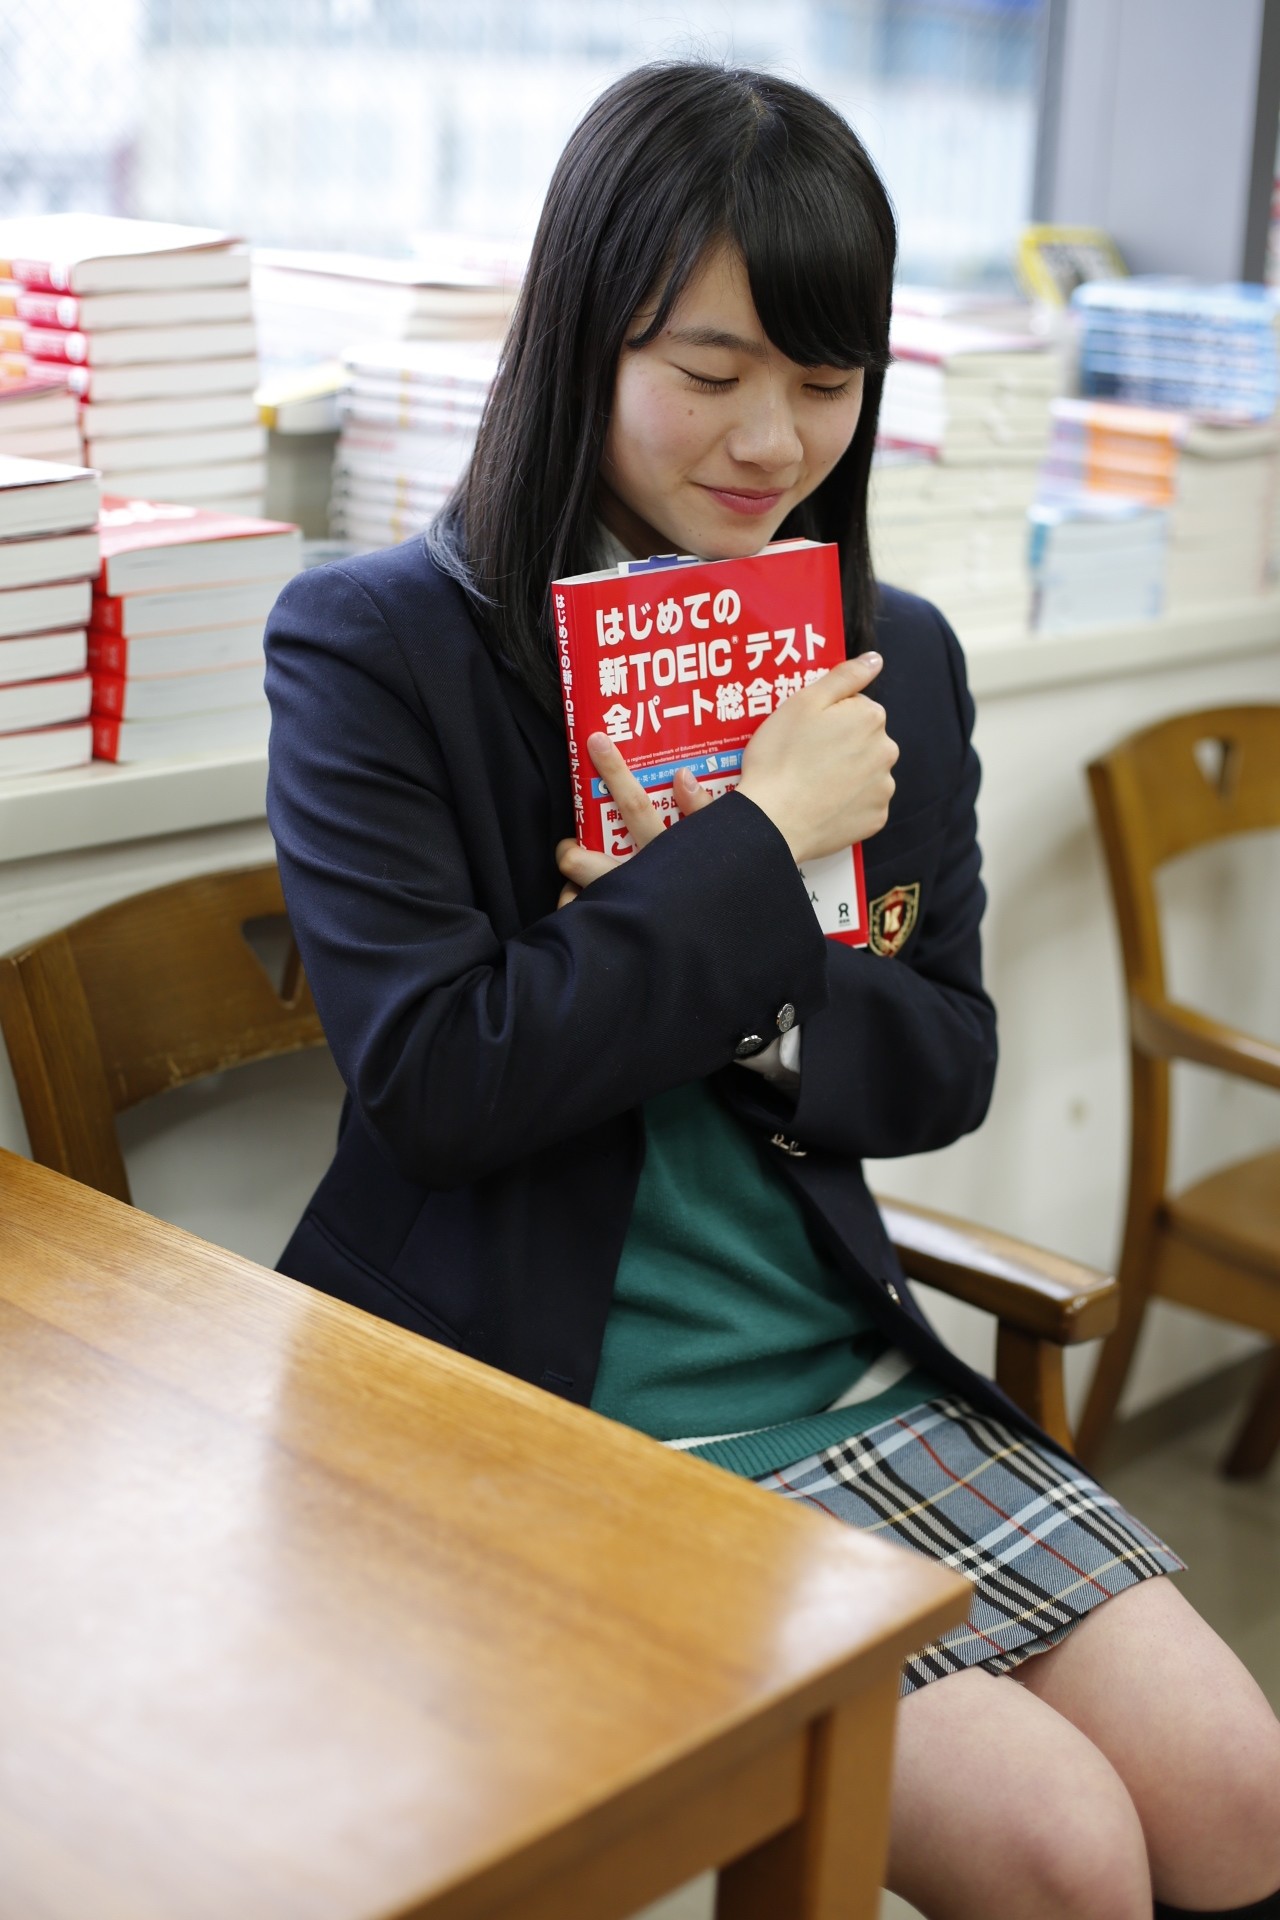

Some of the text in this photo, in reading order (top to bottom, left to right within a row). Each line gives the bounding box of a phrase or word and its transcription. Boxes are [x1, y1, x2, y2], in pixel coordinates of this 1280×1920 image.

[595, 588, 741, 647] はじめての
[630, 752, 653, 763] registered
[652, 748, 675, 759] trademark
[680, 741, 706, 752] Educational
[706, 738, 723, 748] Testing
[723, 736, 740, 744] Service
[654, 754, 675, 764] endorsed
[680, 749, 702, 760] approved
